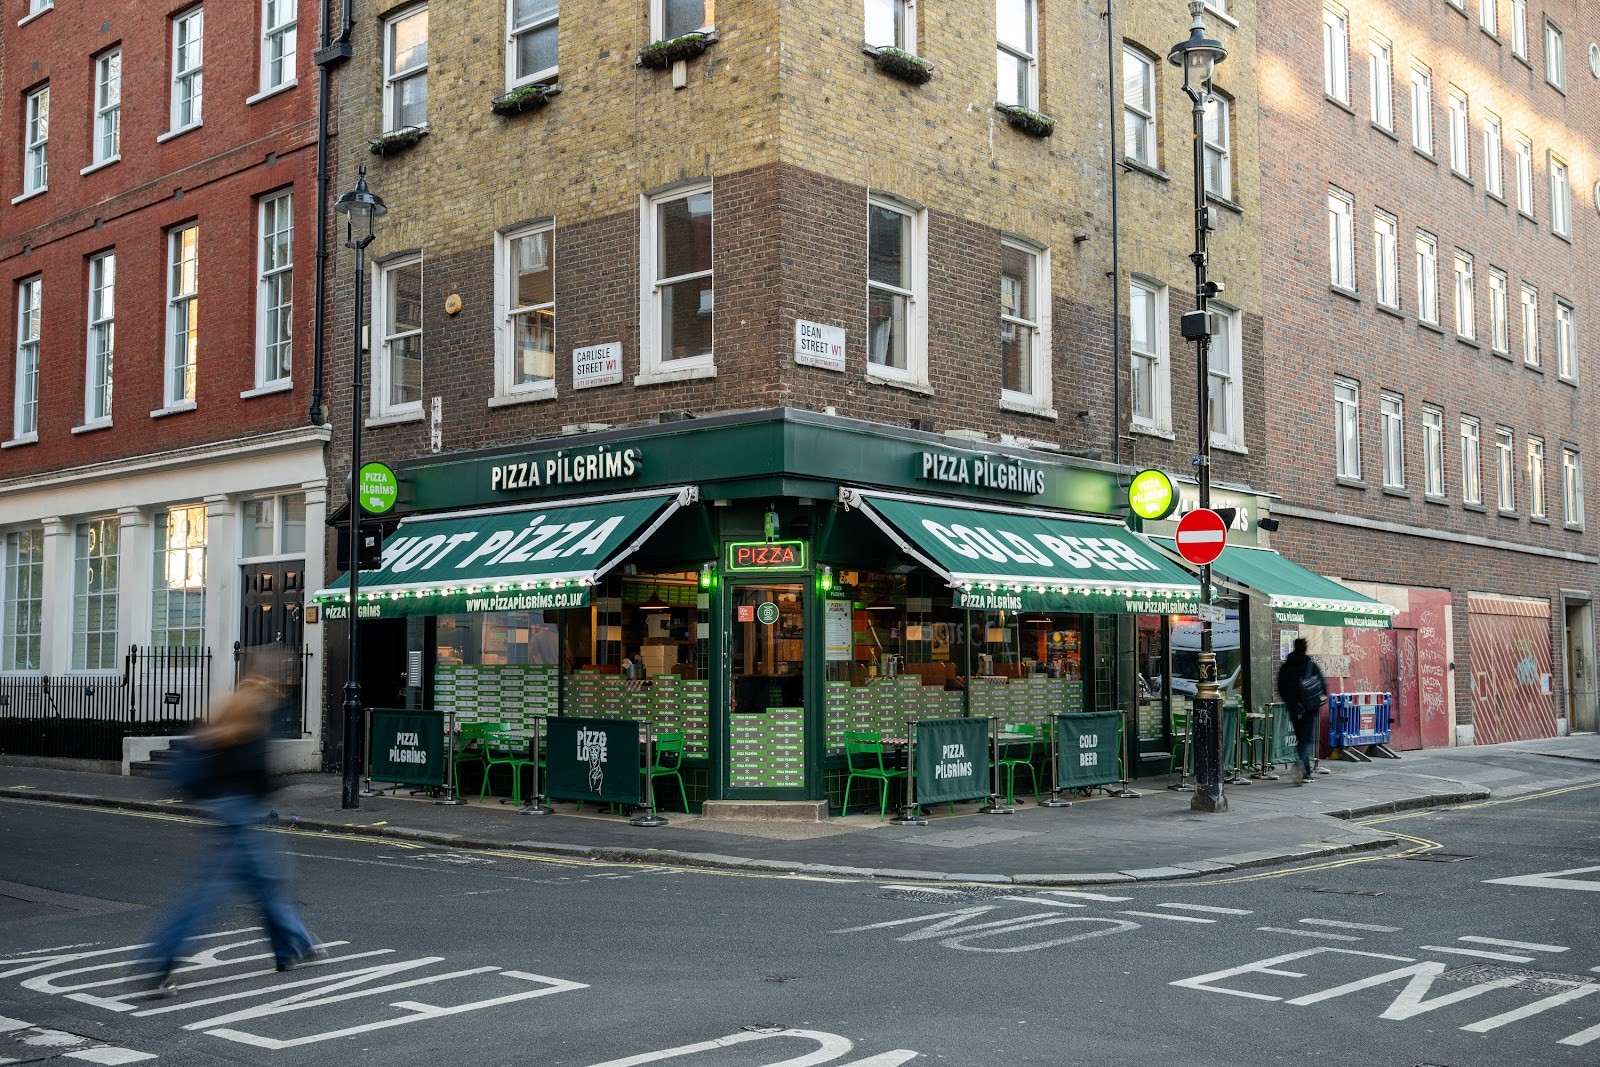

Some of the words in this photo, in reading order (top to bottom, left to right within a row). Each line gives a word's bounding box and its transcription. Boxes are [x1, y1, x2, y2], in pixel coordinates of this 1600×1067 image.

[801, 324, 822, 339] DEAN
[577, 347, 610, 363] CARLISLE
[801, 338, 829, 354] STREET
[831, 344, 842, 357] W1
[577, 361, 603, 375] STREET
[605, 359, 617, 371] W1
[491, 461, 541, 491] PIZZA
[546, 445, 637, 485] PILGRIMS
[922, 452, 970, 484] PIZZA
[974, 454, 1046, 495] PILGRIMS
[365, 472, 388, 483] PIZZA
[1138, 478, 1161, 491] PIZZA
[358, 531, 474, 574] HOT
[455, 514, 626, 569] PIZZA
[921, 518, 1054, 568] COLD
[1033, 533, 1162, 571] BEER
[738, 547, 795, 564] PIZZA
[465, 591, 583, 613] WWW.PIZZAPILGRIMS.CO.UK
[960, 592, 985, 608] PIZZA
[986, 591, 1022, 610] PILGRIMS
[325, 604, 347, 619] PIZZA
[396, 731, 419, 746] PIZZA
[1079, 734, 1098, 749] COLD
[1284, 735, 1299, 748] PIZZ
[389, 745, 427, 765] PILGRIMS
[576, 745, 608, 763] LOE
[942, 744, 965, 760] PIZZA
[1079, 752, 1098, 767] BEER
[935, 760, 973, 780] PILGRIMS
[828, 905, 1142, 953] NO
[1167, 946, 1600, 1047] ENT
